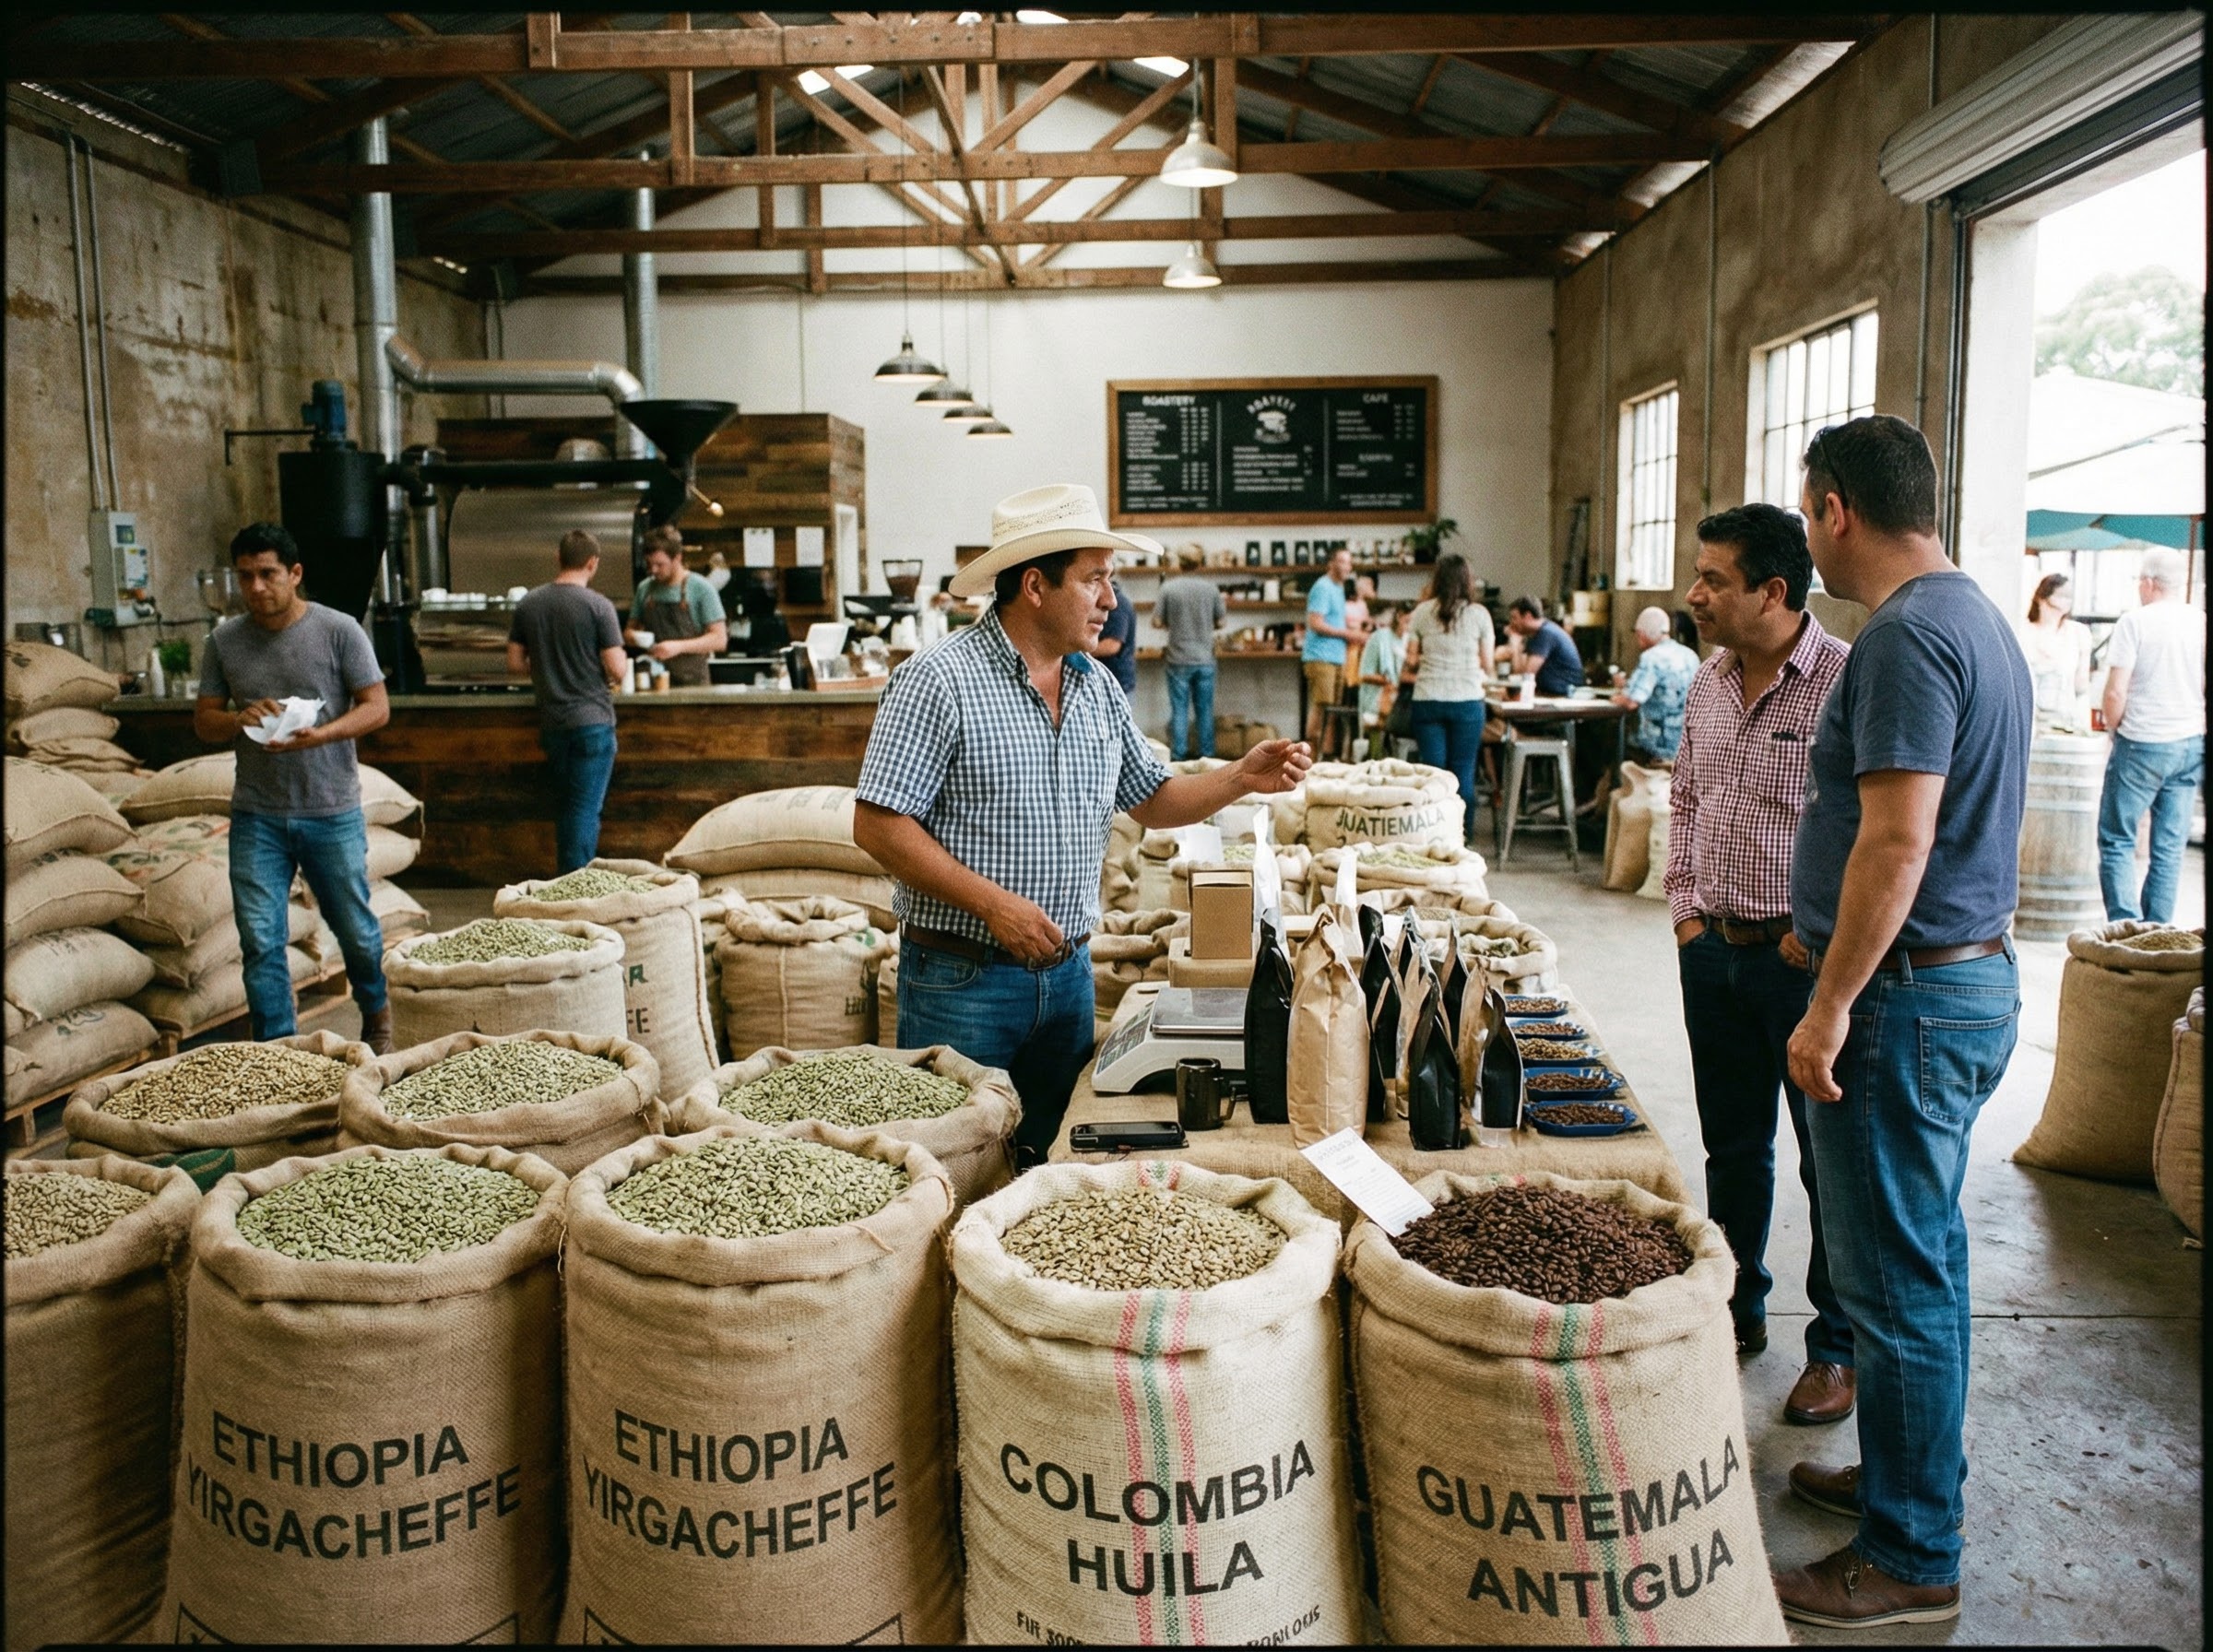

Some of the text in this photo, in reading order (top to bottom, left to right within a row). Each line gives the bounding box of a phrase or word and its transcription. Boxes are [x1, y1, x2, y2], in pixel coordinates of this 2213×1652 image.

[213, 1410, 469, 1488] ETHIOPIA
[615, 1408, 848, 1484] ETHIOPIA
[1000, 1439, 1316, 1527] COLOMBIA
[1416, 1434, 1740, 1541] GUATEMALA
[189, 1452, 521, 1560] YIRGACHEFFE
[583, 1453, 897, 1559] YIRGACHEFFE
[1067, 1539, 1265, 1598] HUILA
[1466, 1528, 1734, 1618] ANTIGUA
